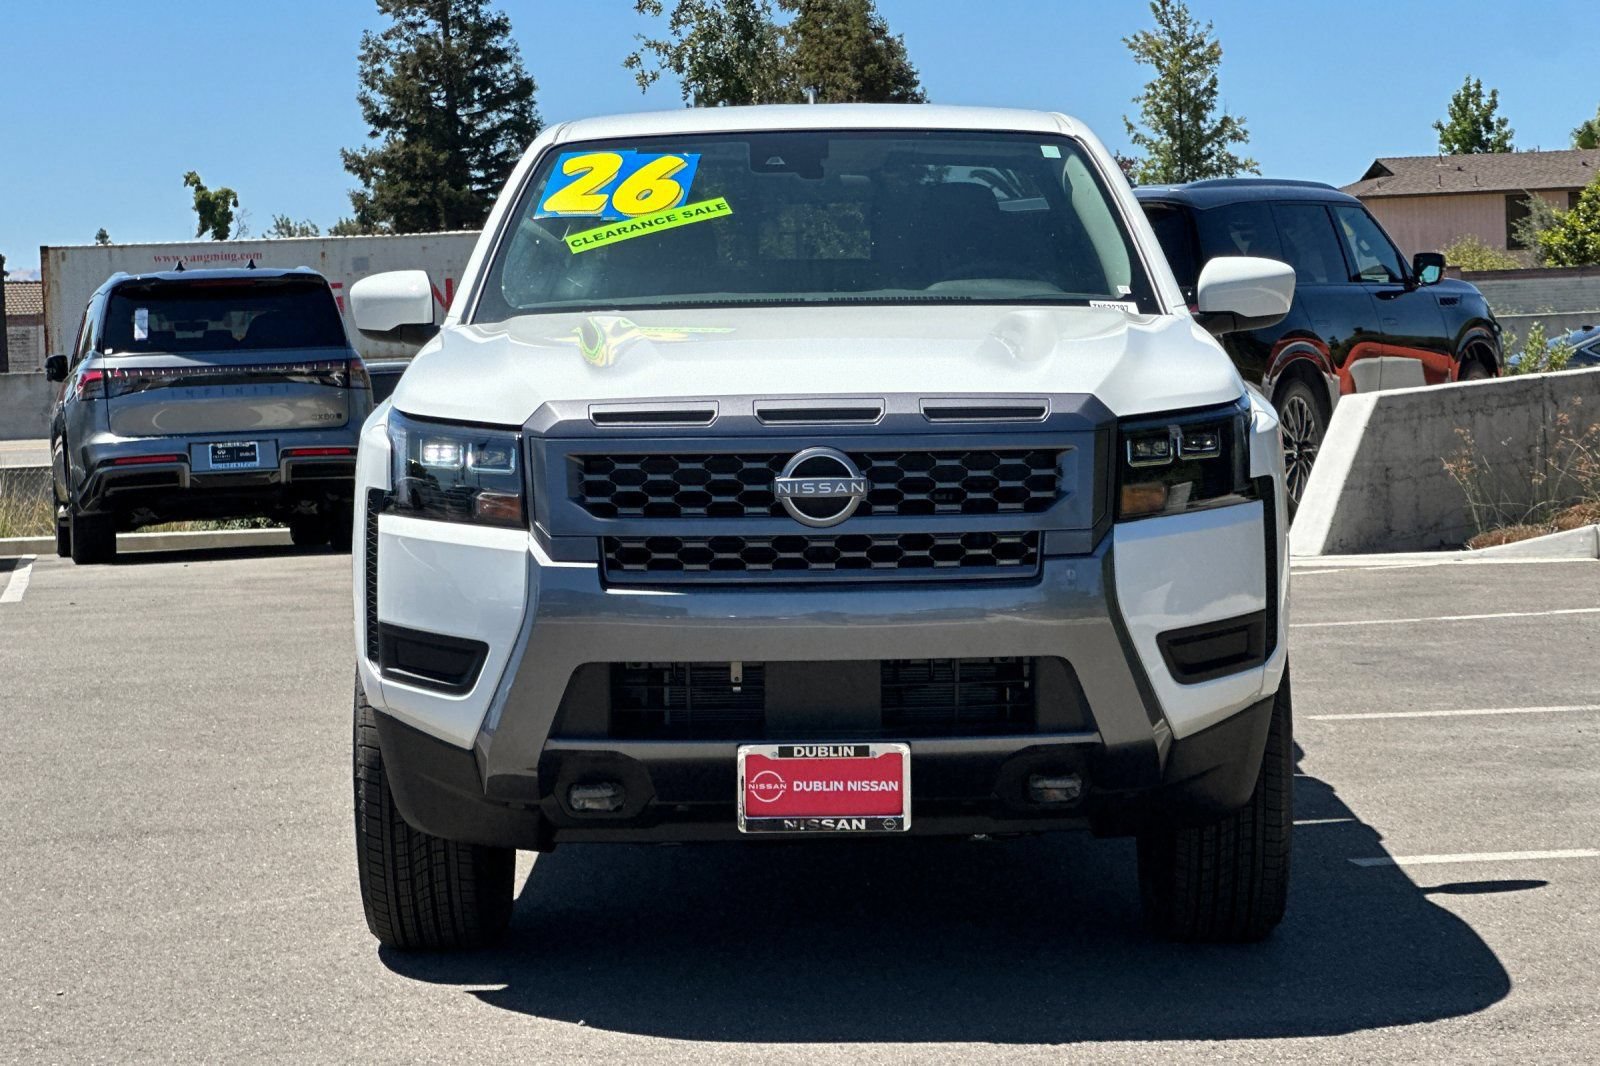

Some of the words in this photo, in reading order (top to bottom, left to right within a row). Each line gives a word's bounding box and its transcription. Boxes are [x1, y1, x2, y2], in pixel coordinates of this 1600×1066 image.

[543, 152, 688, 218] 26
[571, 215, 678, 248] CLEARANCE
[682, 202, 728, 218] SALE
[153, 251, 263, 265] www.yangming.com
[777, 482, 864, 494] NISSAN
[793, 746, 855, 757] DUBLIN
[793, 780, 844, 792] DUBLIN
[847, 780, 899, 792] NISSAN
[783, 819, 866, 830] NISSAN
